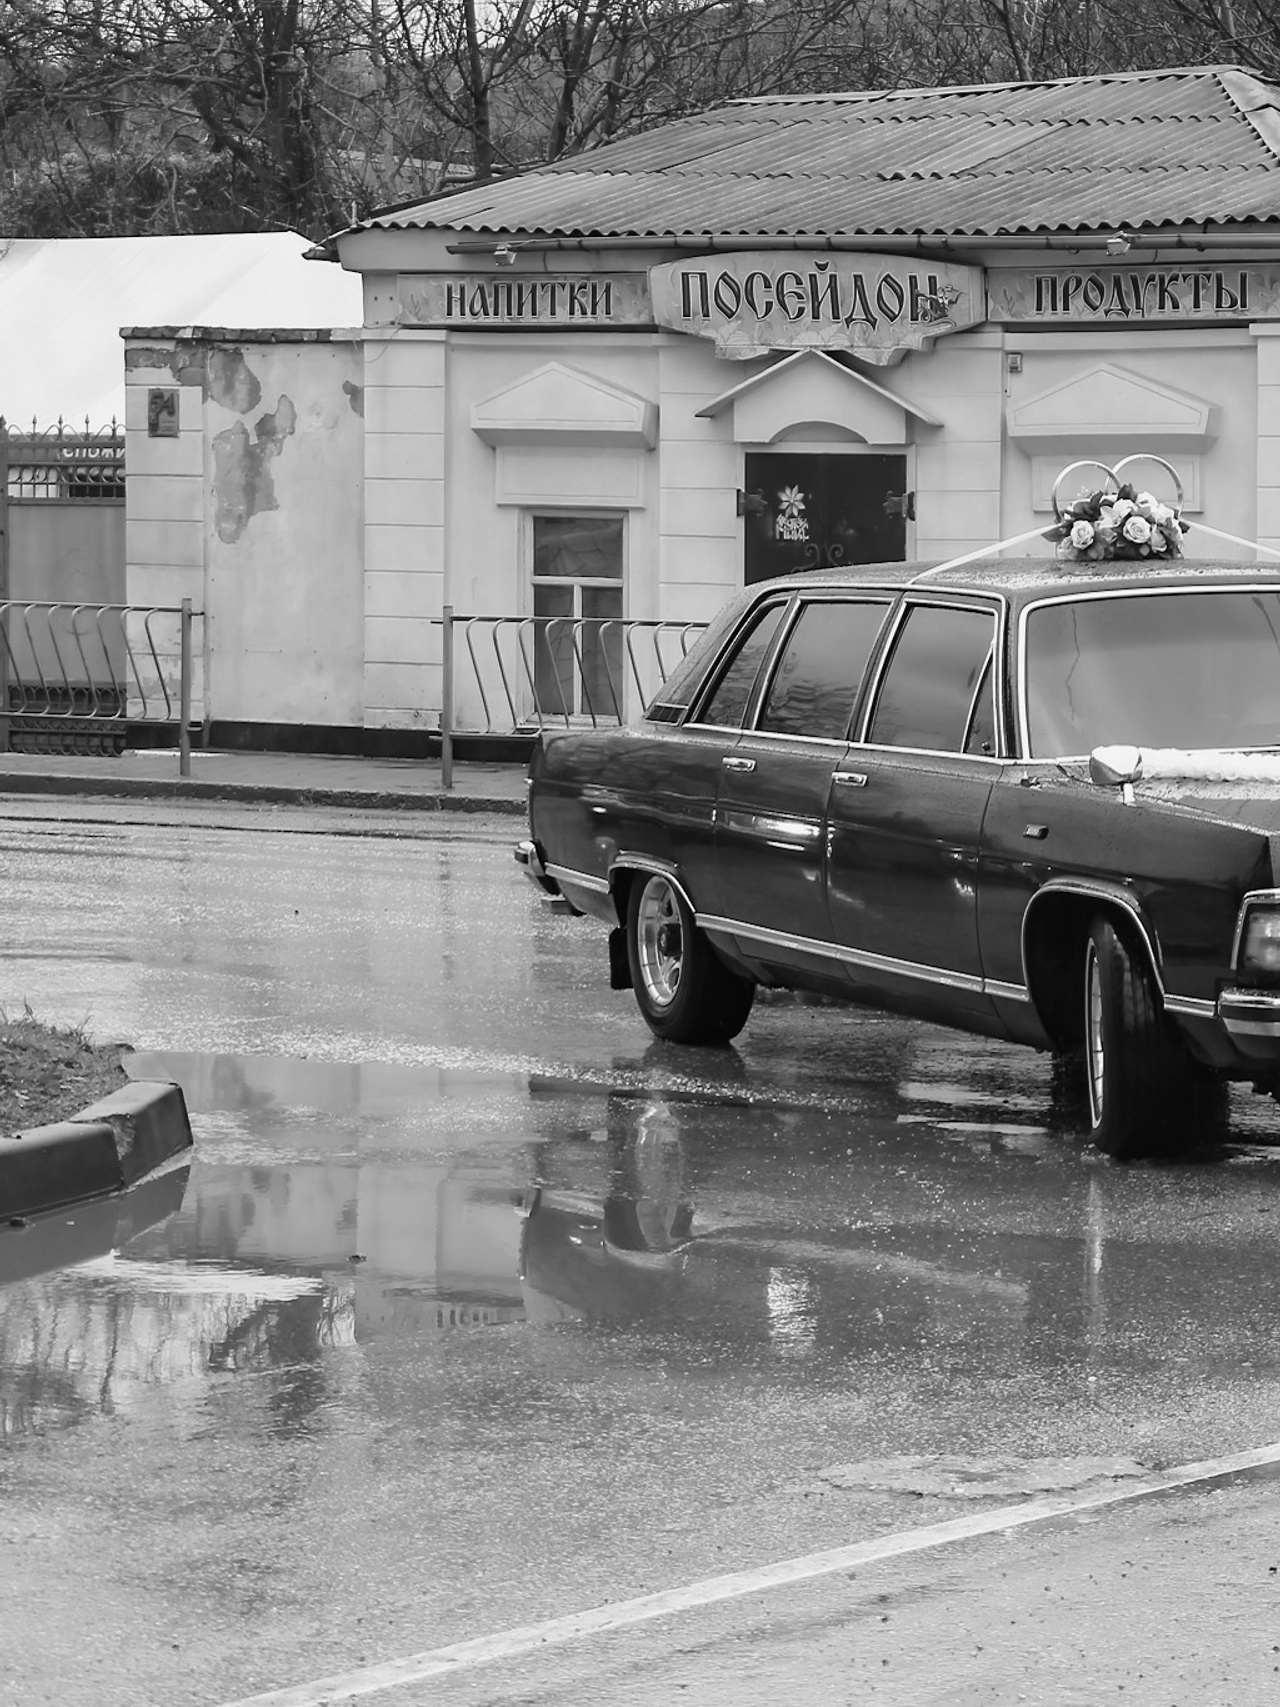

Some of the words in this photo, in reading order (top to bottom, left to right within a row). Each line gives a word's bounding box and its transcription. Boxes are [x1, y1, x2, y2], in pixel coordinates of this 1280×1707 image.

[446, 280, 613, 318] НАПИТКИ
[680, 260, 938, 331] ПОСЕЙДОН
[1034, 271, 1249, 319] ПРОДУКТЫ
